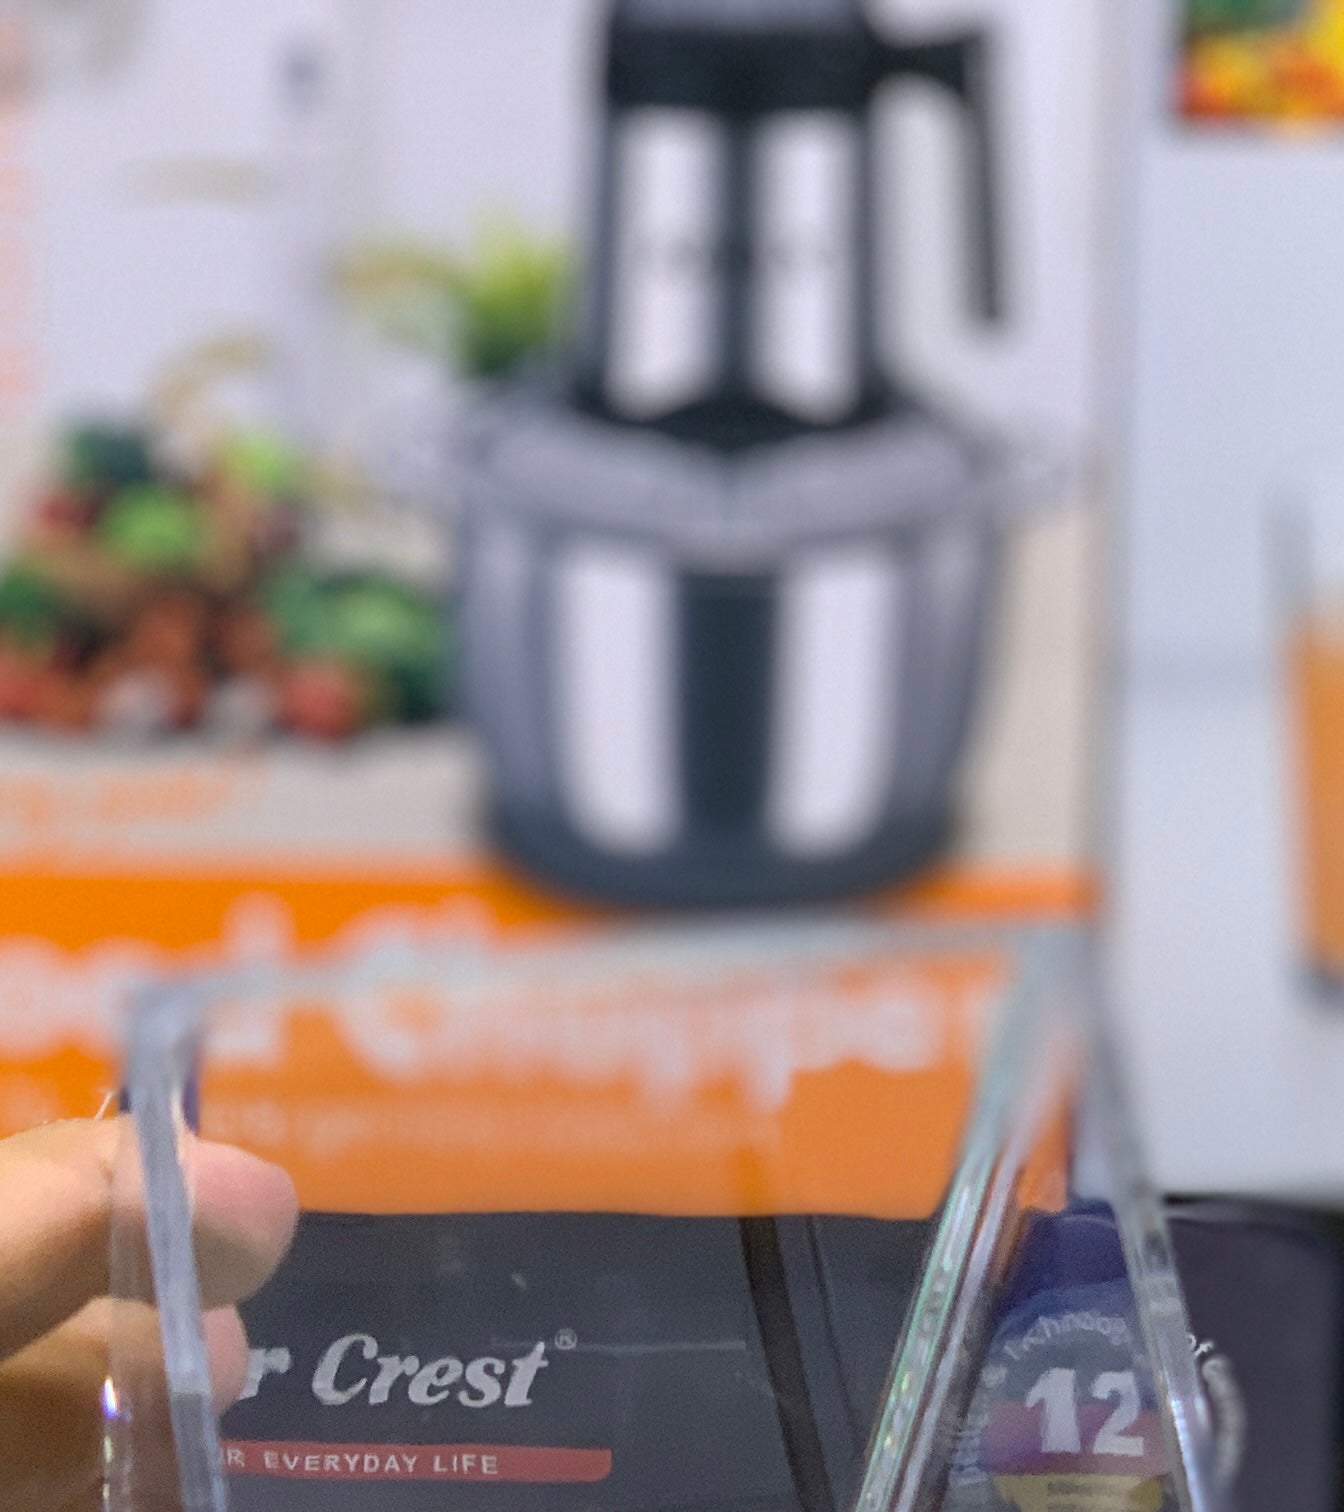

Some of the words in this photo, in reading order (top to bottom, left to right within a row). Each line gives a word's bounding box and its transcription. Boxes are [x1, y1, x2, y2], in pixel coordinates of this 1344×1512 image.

[312, 1333, 549, 1408] Crest
[1026, 1367, 1143, 1457] 12
[264, 1453, 417, 1474] EVERYDAY
[433, 1455, 499, 1475] LIFE
